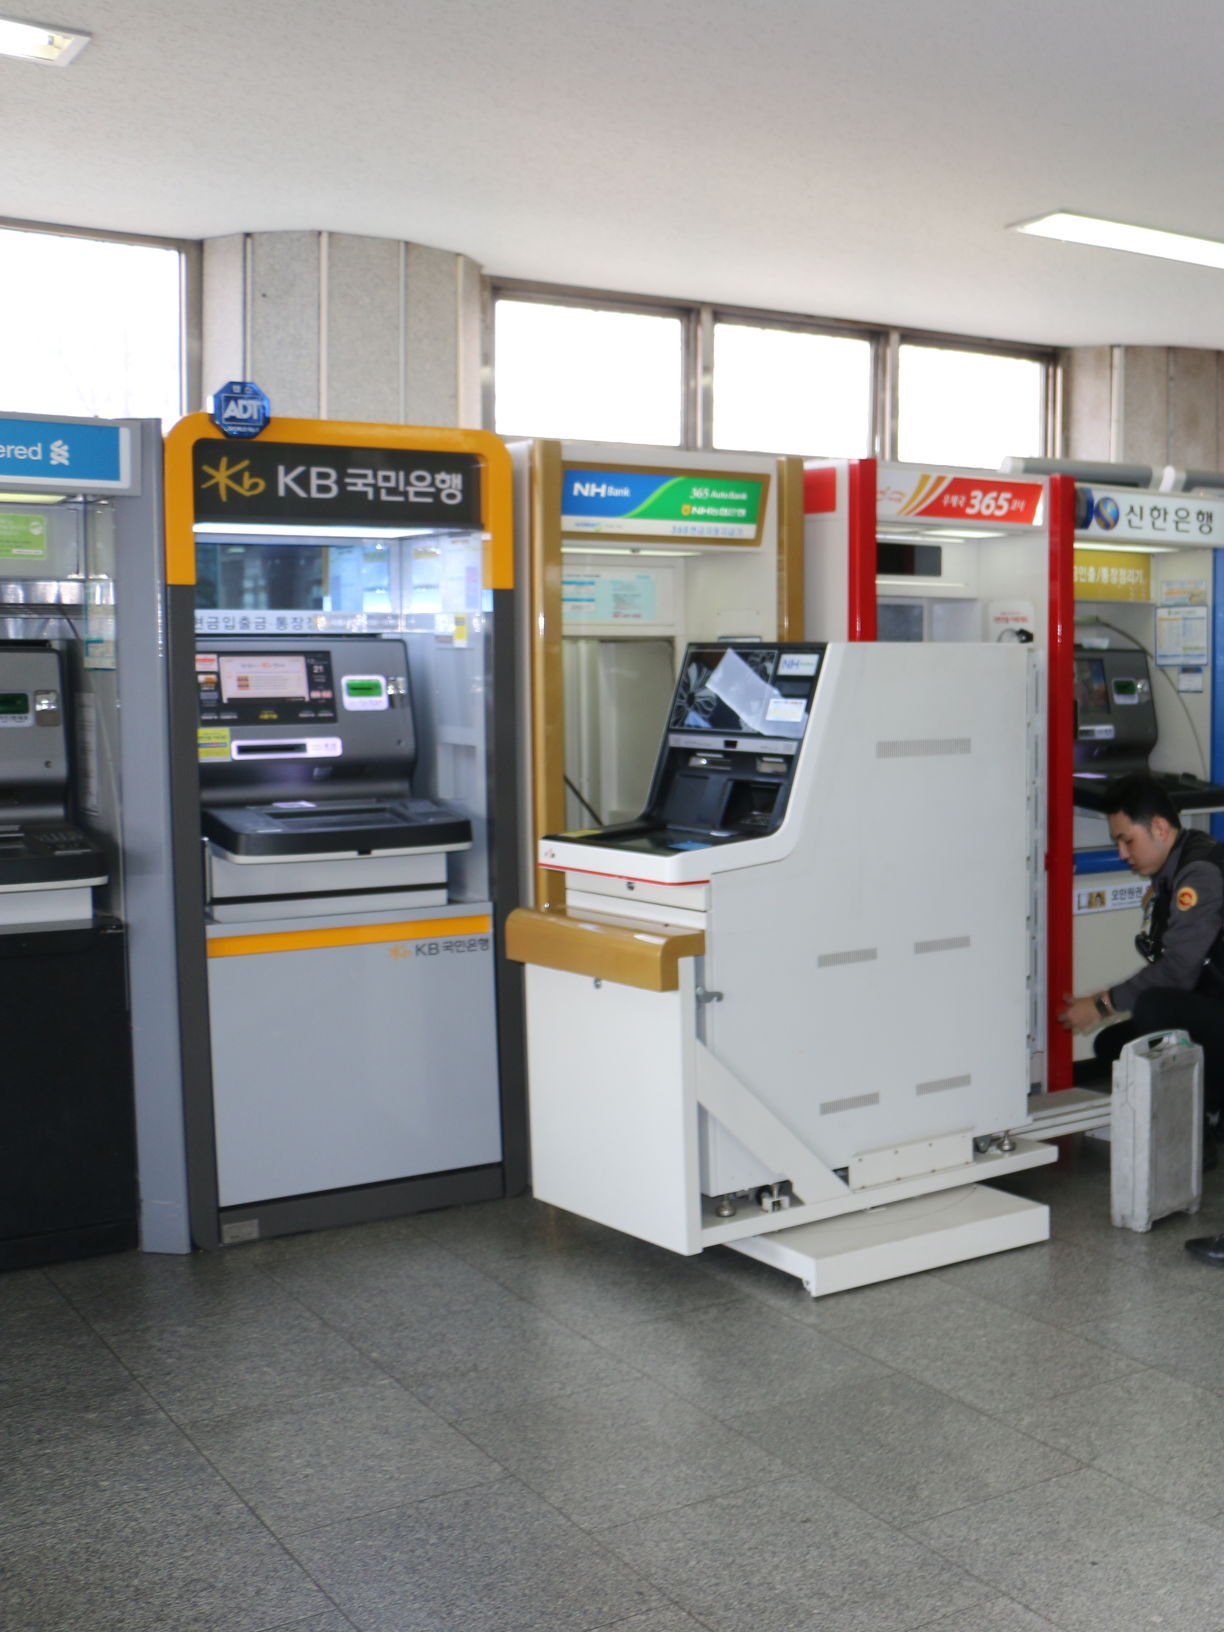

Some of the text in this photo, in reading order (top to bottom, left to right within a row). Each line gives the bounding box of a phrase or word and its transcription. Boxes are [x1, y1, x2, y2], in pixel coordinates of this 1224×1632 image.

[223, 399, 262, 420] ADT
[690, 487, 710, 500] 365
[965, 489, 1012, 517] 365
[1125, 504, 1214, 536] 신한은행
